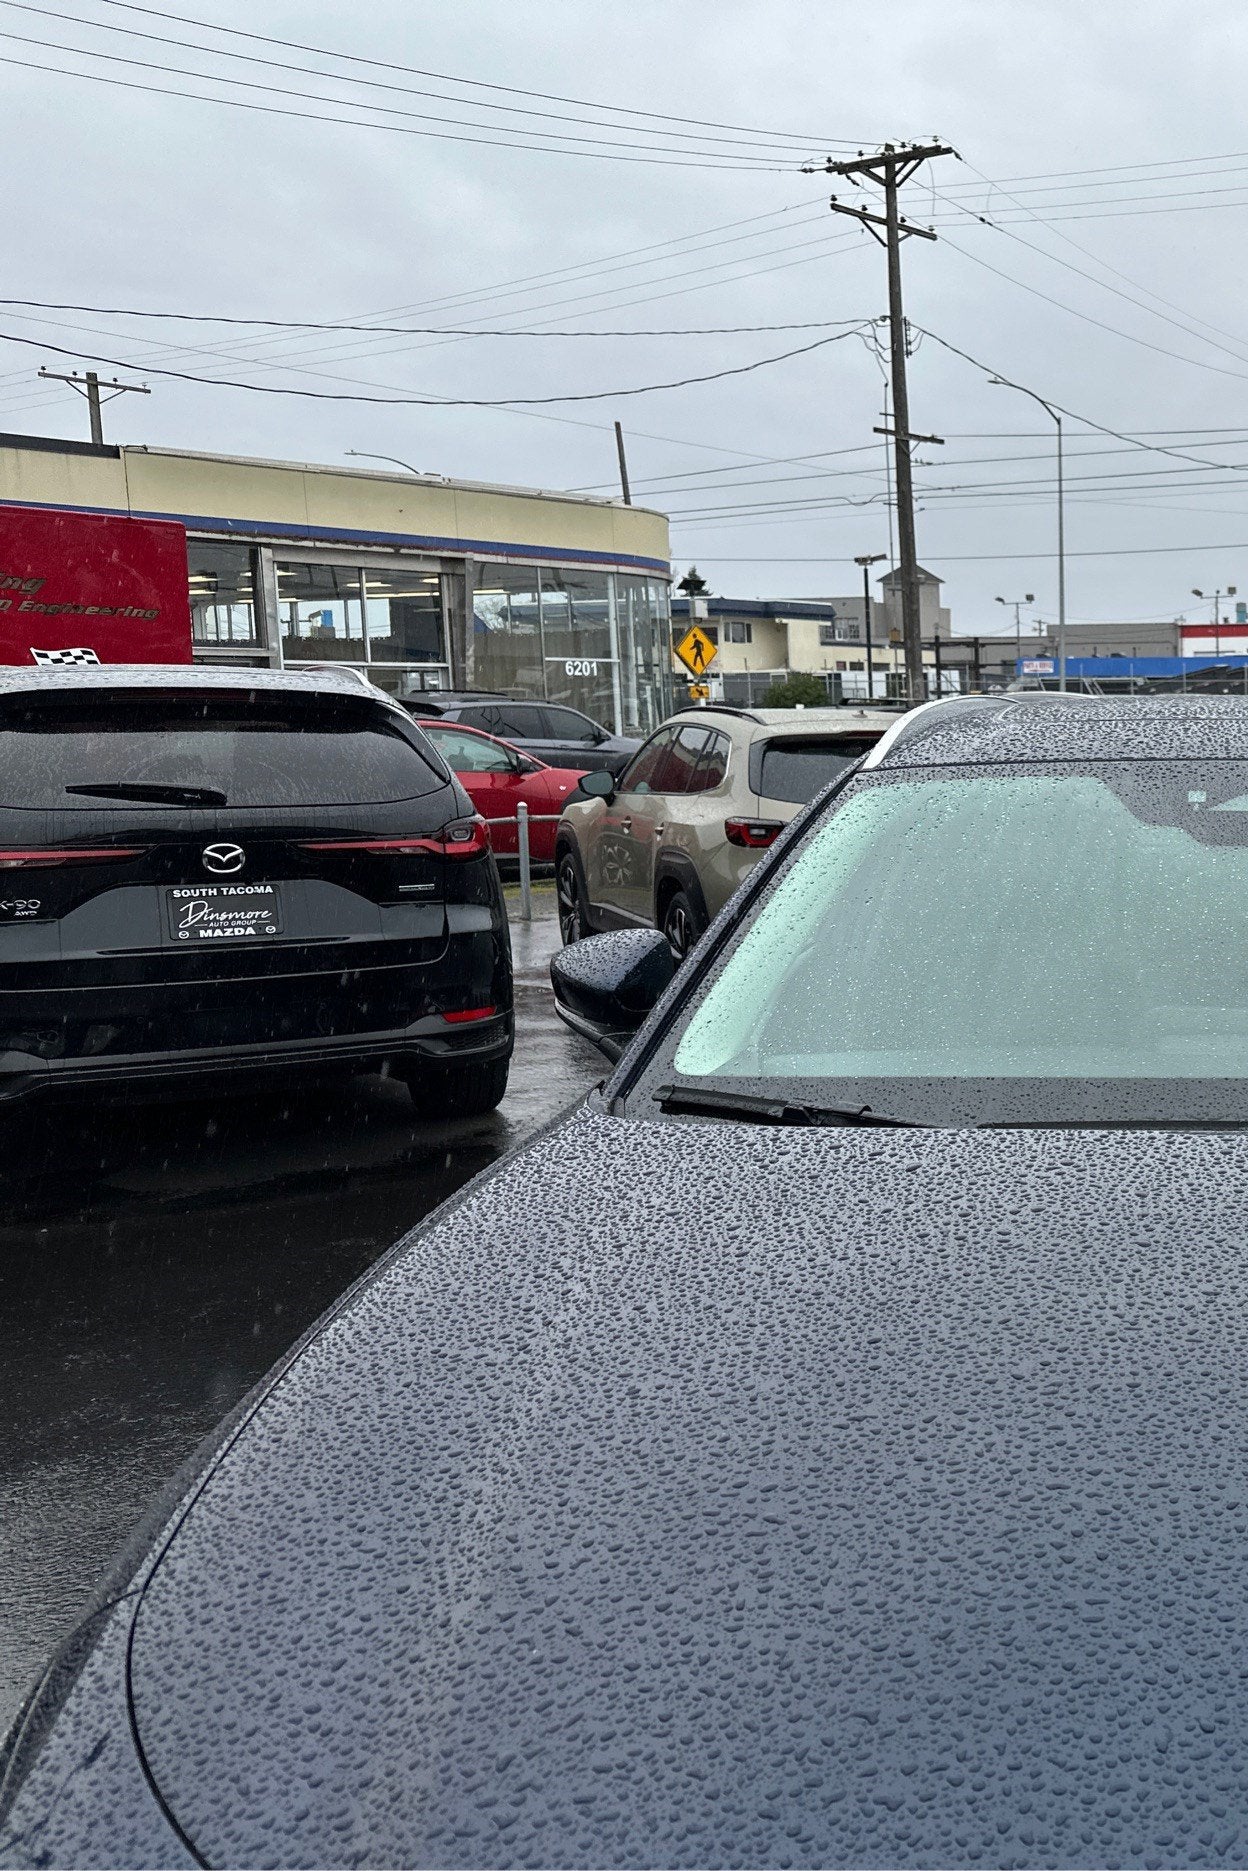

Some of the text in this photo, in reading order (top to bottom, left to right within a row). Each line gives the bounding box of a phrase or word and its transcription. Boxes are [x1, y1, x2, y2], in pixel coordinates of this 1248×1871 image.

[18, 600, 160, 621] Engineering
[565, 661, 597, 676] 6201
[172, 885, 273, 898] SOUTH TACOMA
[179, 900, 272, 929] Dinsmore
[199, 926, 256, 938] MAZDA
